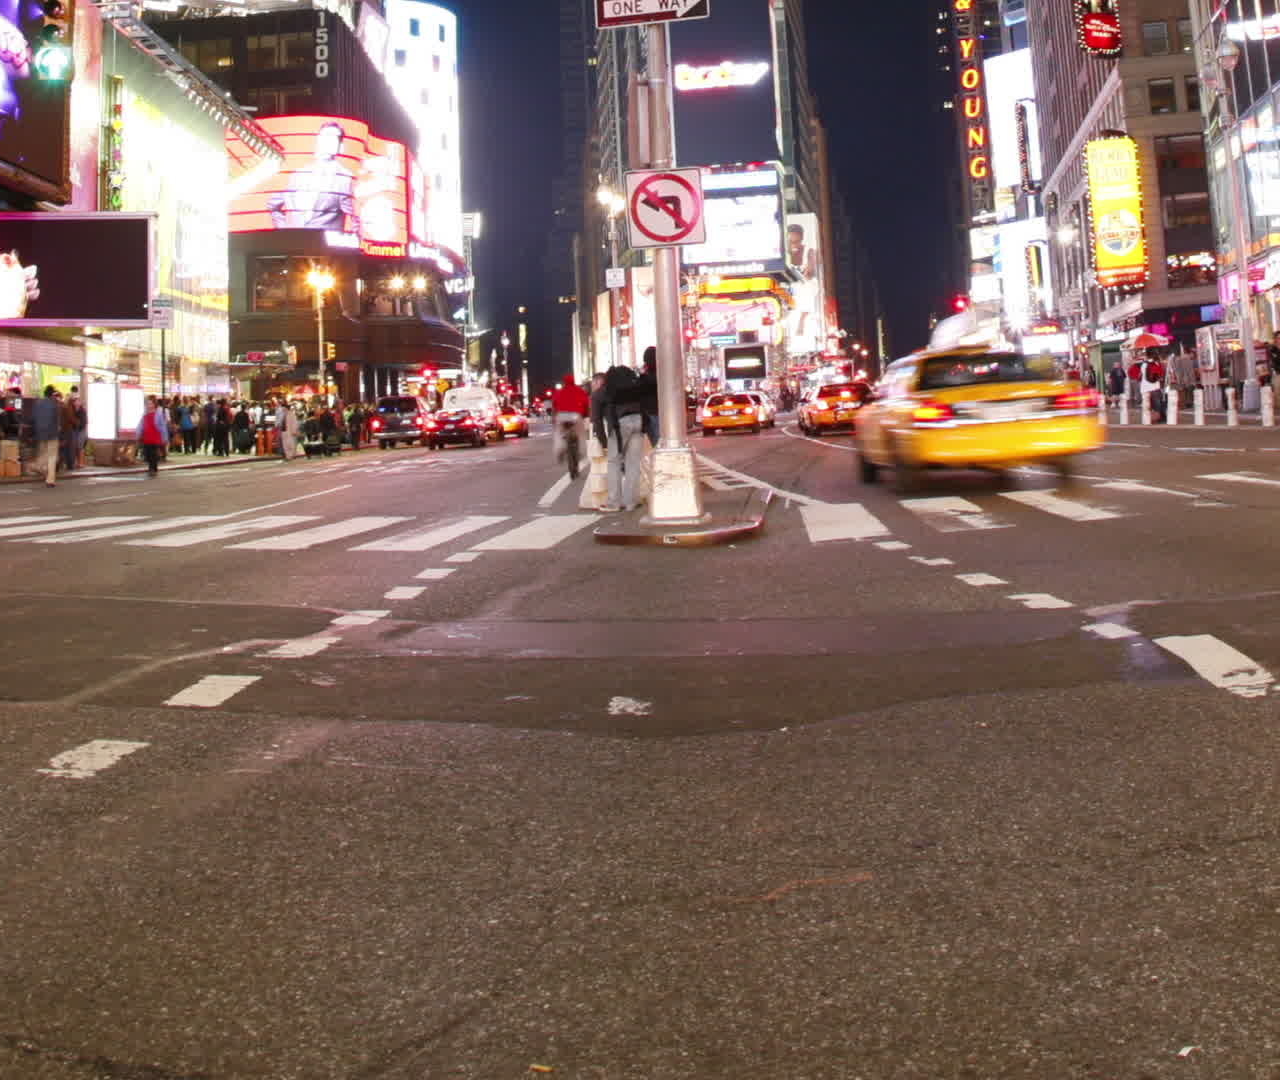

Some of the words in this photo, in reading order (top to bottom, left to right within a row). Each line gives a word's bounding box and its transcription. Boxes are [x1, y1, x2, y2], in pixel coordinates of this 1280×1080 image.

[612, 0, 643, 16] ONE
[315, 11, 329, 78] 1500
[961, 38, 988, 179] YOUNG
